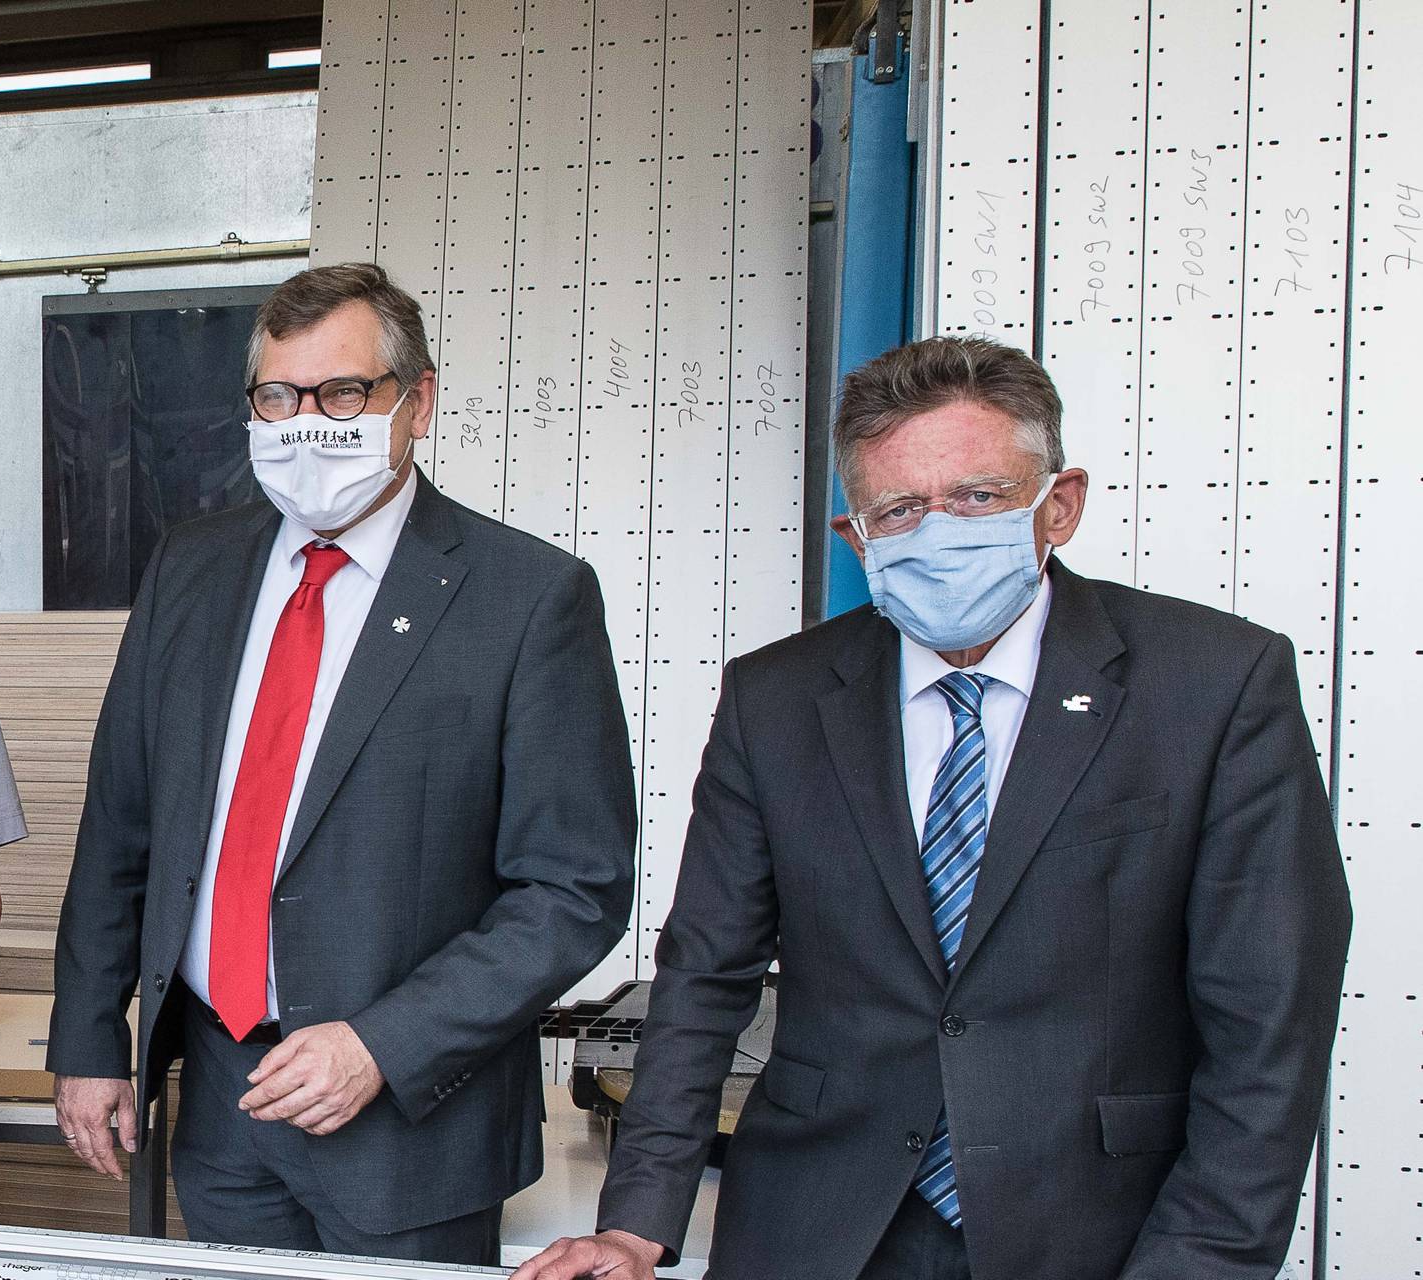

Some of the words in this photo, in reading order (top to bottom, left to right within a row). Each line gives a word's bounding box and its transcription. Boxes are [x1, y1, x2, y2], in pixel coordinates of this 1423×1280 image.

[1089, 175, 1109, 229] SW2
[1183, 149, 1212, 210] SW3
[974, 190, 1005, 256] SW1
[1274, 207, 1312, 296] 7103
[1384, 183, 1423, 274] 7104
[1080, 240, 1111, 322] 7009
[1177, 228, 1211, 305] 7009
[603, 338, 632, 397] 4004
[678, 361, 705, 428] 7003
[755, 360, 782, 436] 7007
[534, 377, 557, 429] 4003
